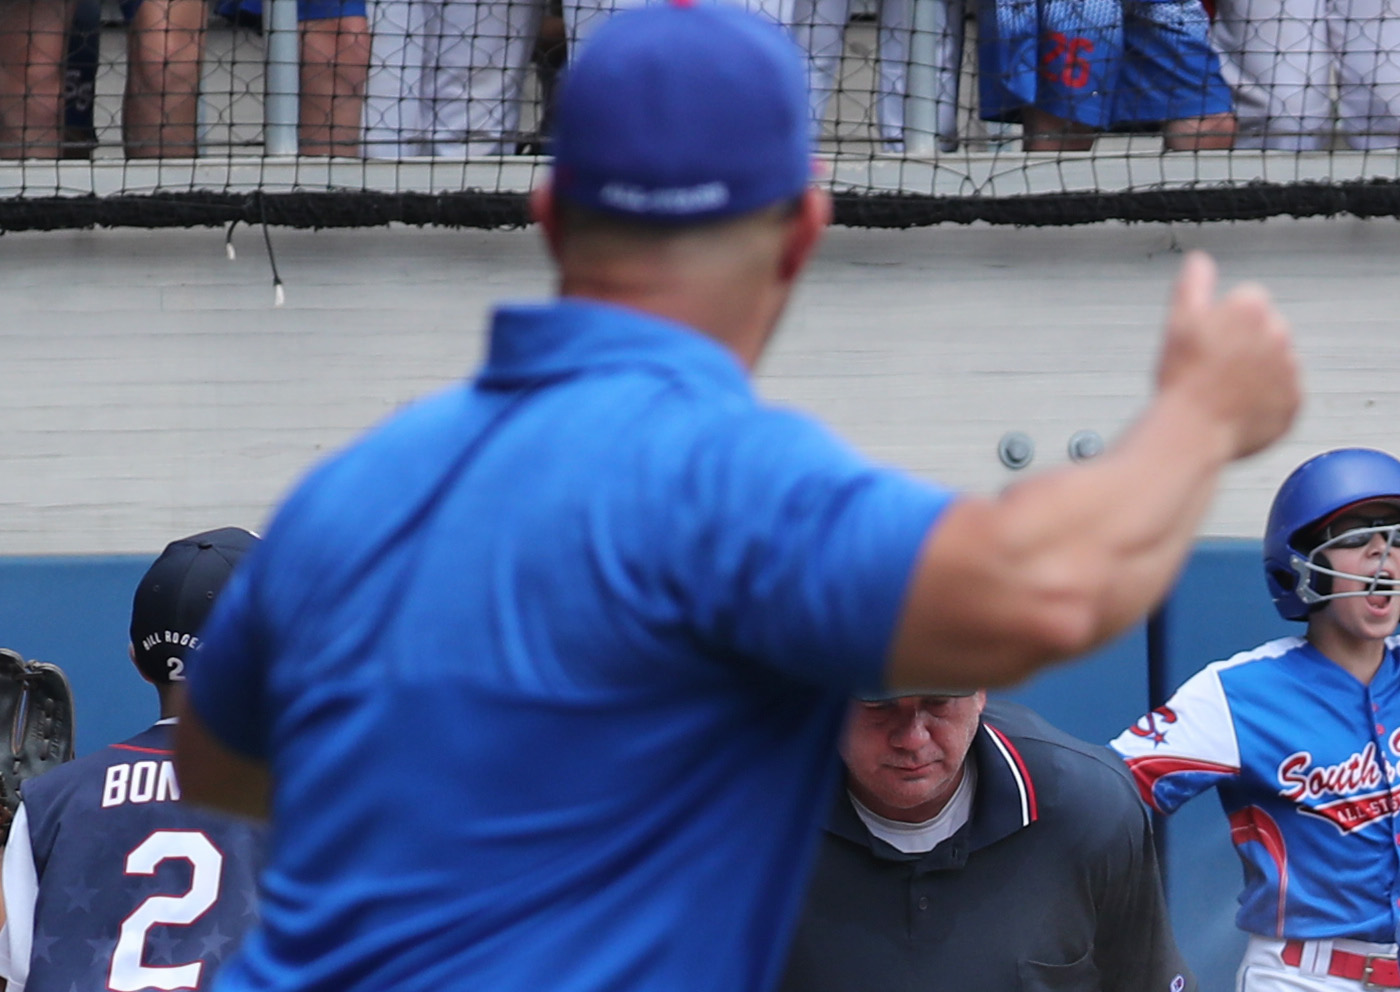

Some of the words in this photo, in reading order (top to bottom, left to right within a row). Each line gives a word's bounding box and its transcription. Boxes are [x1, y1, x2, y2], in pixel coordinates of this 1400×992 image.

[1043, 30, 1095, 89] 26
[142, 632, 162, 652] BILL
[166, 656, 187, 681] 2
[1278, 741, 1395, 803] South
